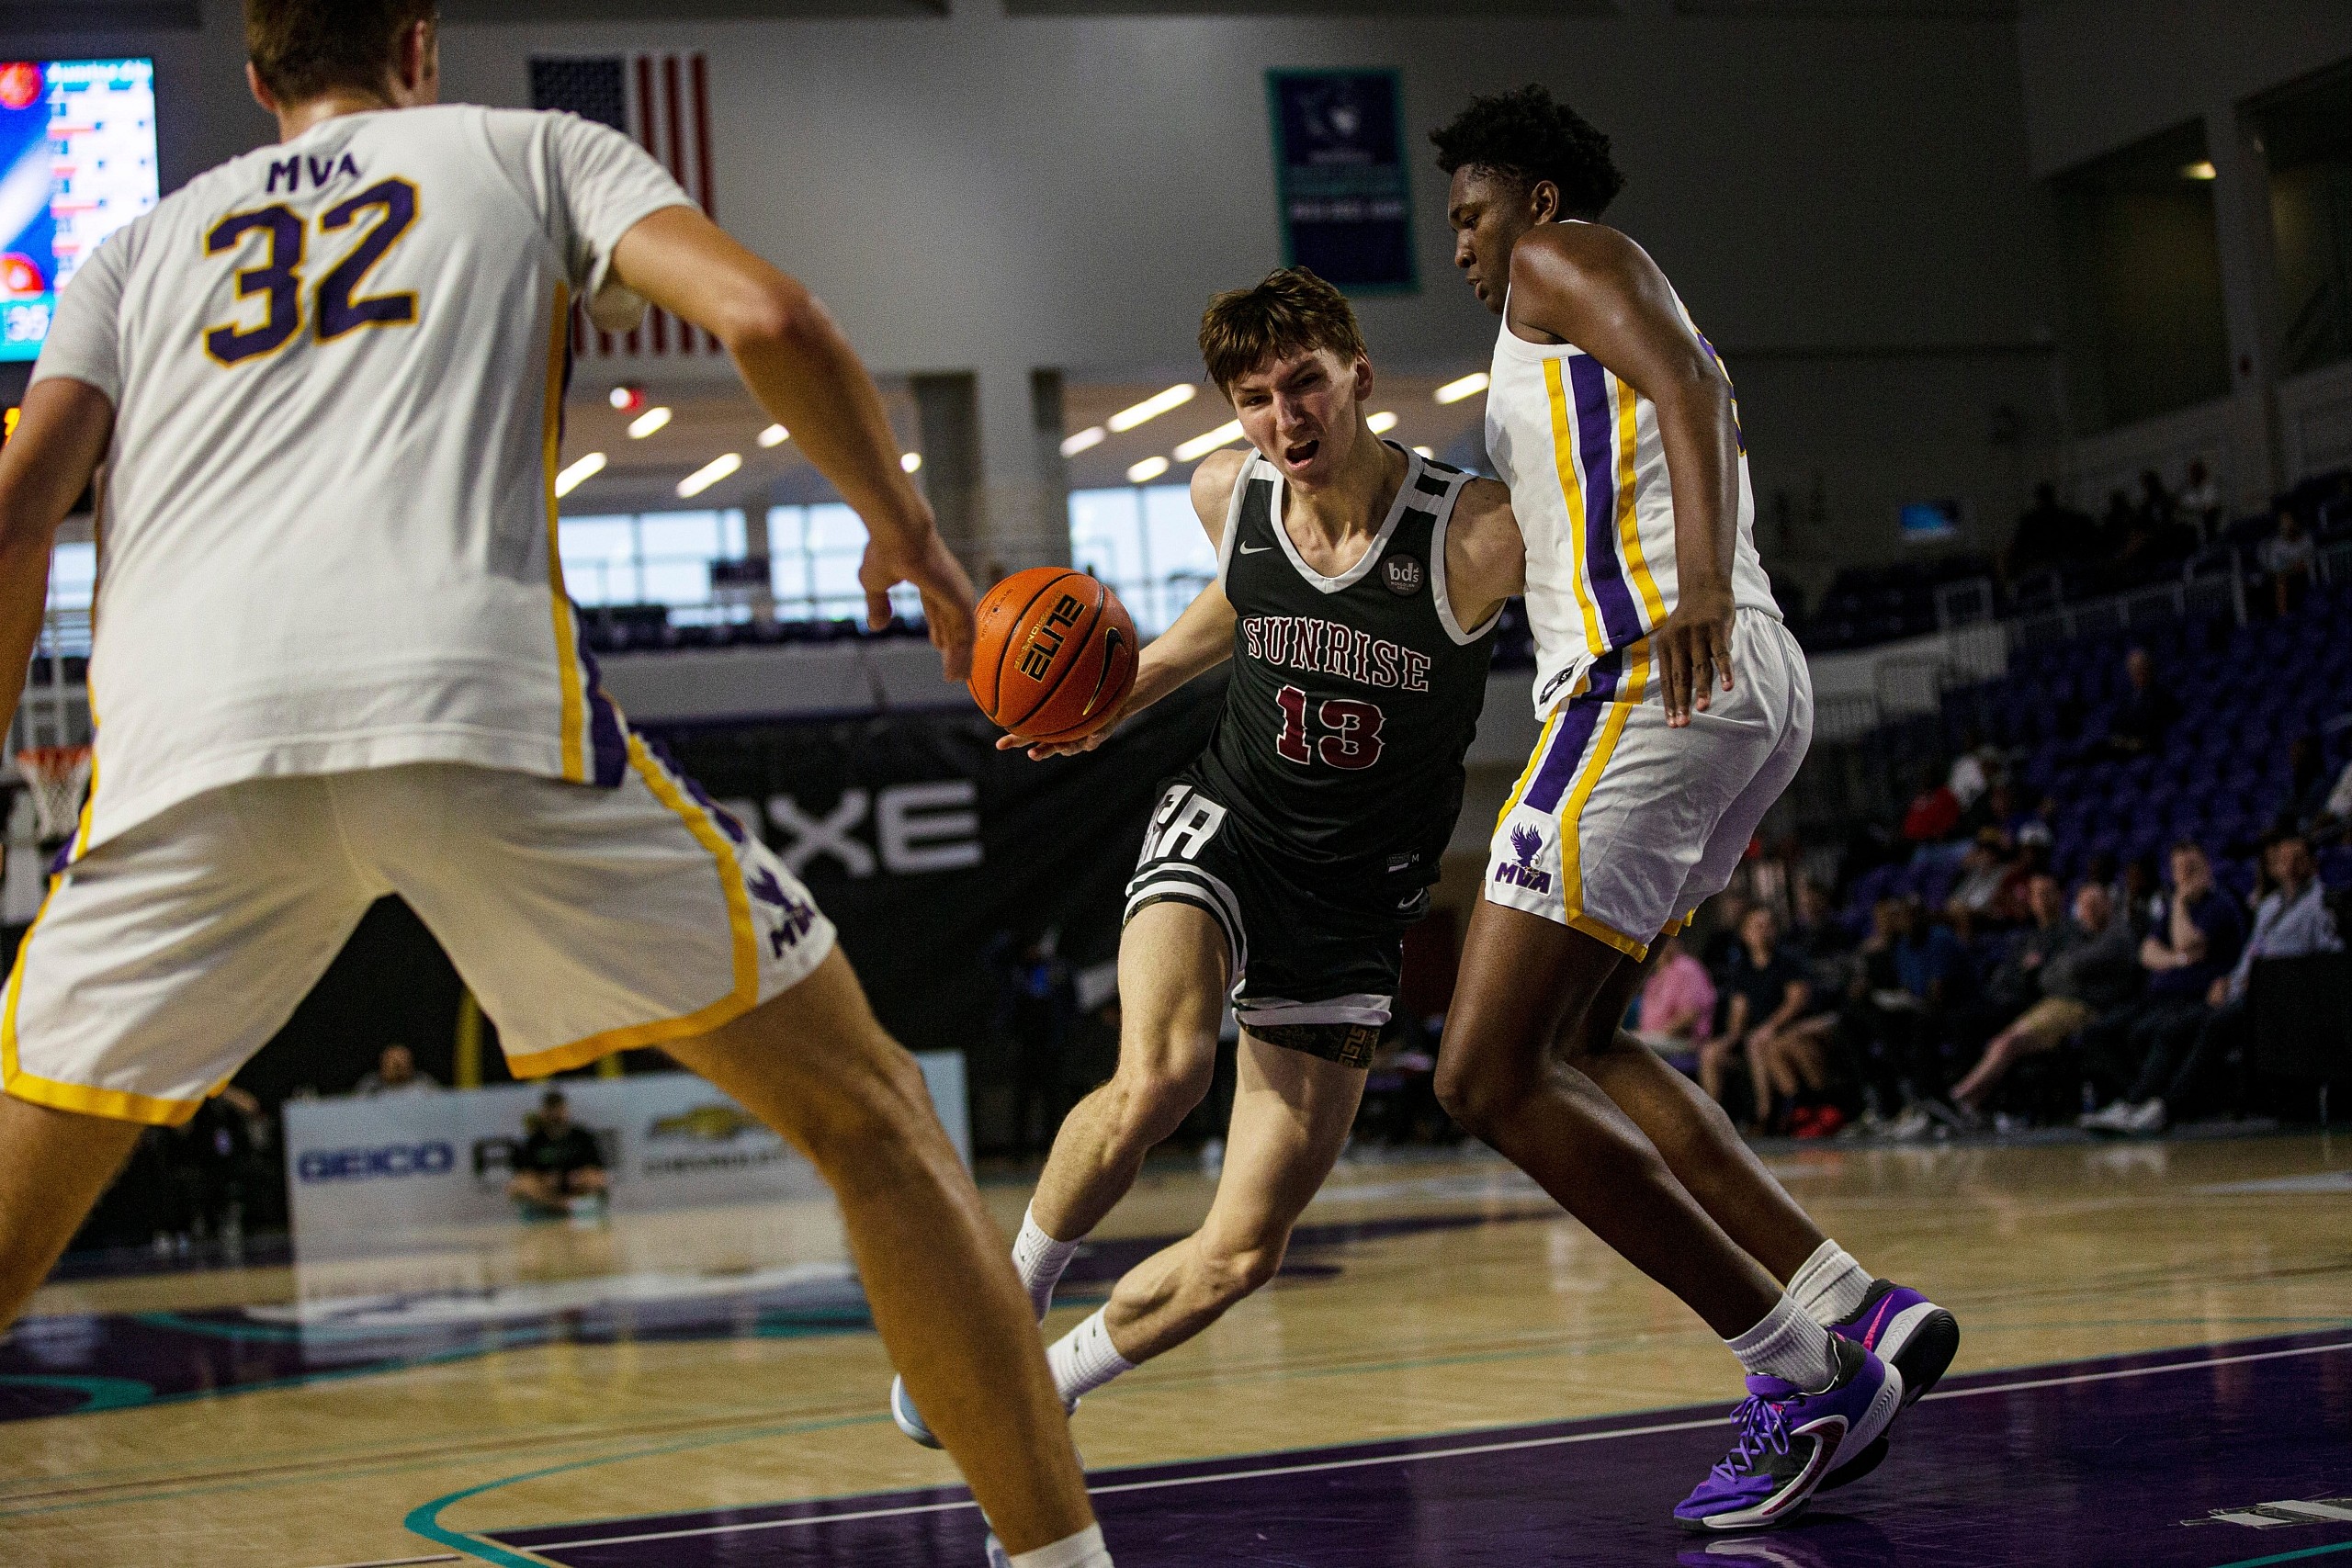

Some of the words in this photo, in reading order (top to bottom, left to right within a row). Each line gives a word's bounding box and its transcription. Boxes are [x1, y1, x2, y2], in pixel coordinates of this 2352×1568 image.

[266, 152, 362, 193] MVA
[202, 175, 421, 370] 32
[1019, 593, 1087, 683] ELITE
[1243, 616, 1431, 693] SUNRISE
[1275, 683, 1387, 771] 13
[1494, 861, 1554, 896] MVA
